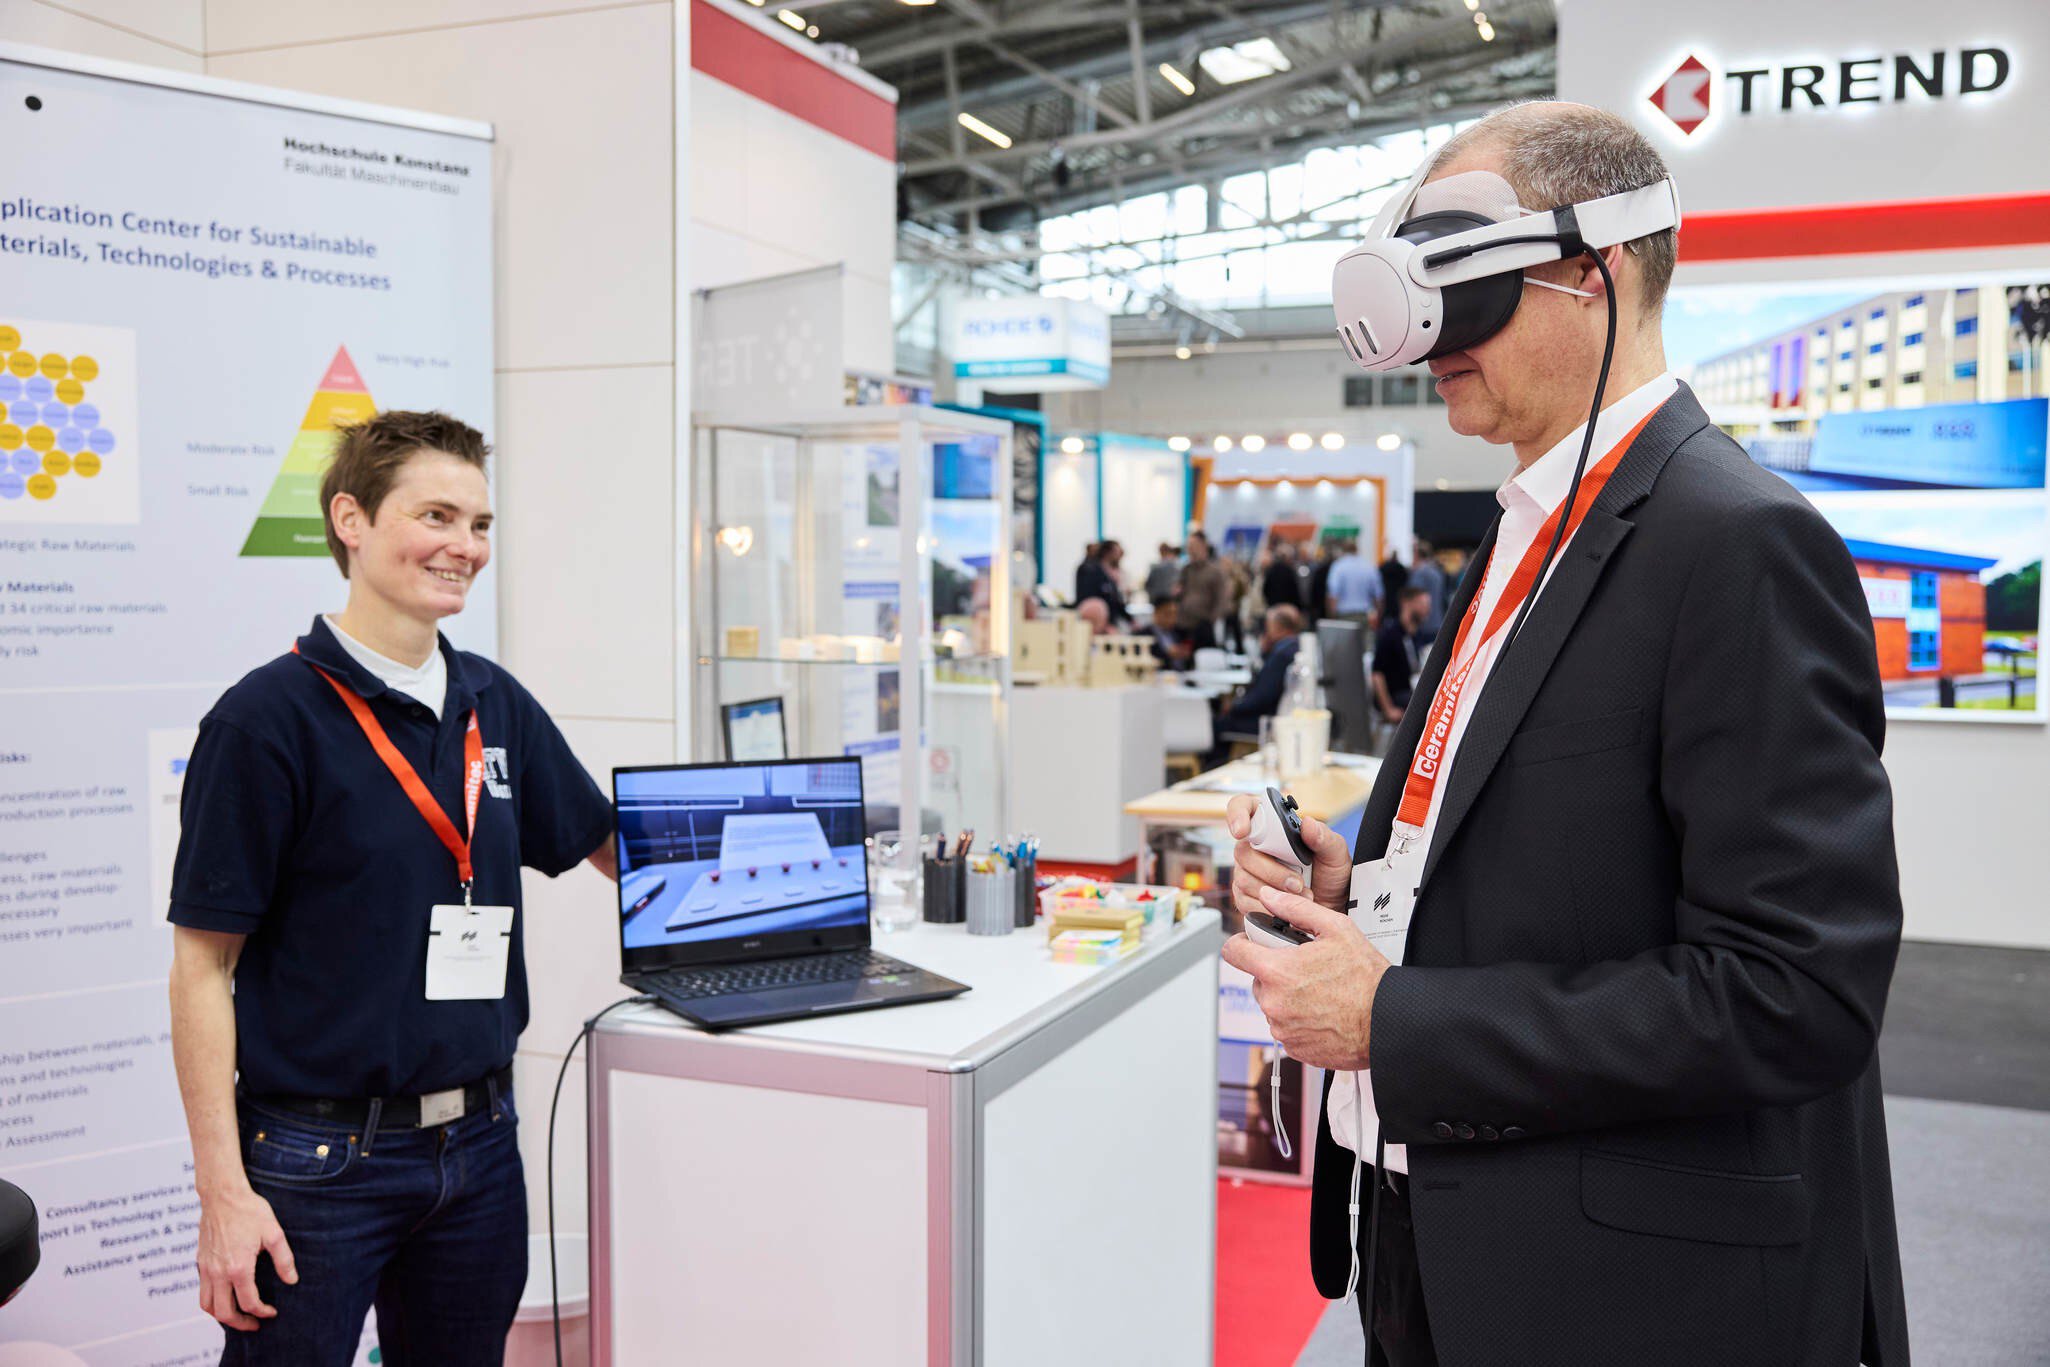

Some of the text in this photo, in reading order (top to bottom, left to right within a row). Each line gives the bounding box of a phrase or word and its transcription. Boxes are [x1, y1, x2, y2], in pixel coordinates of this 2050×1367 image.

[1726, 47, 2010, 114] TREND
[283, 137, 471, 177] Hochschule Konstanz
[284, 156, 460, 196] Fakultät Maschinenbau
[0, 198, 378, 258] plication Center for Sustainable
[98, 241, 253, 279] Technologies
[260, 259, 278, 279] &
[286, 262, 392, 291] Processes
[7, 580, 75, 594] Materials
[5, 1124, 87, 1149] Assessment
[45, 1196, 129, 1221] Consultancy
[90, 1209, 163, 1233] Technology
[64, 1253, 134, 1279] Assistance
